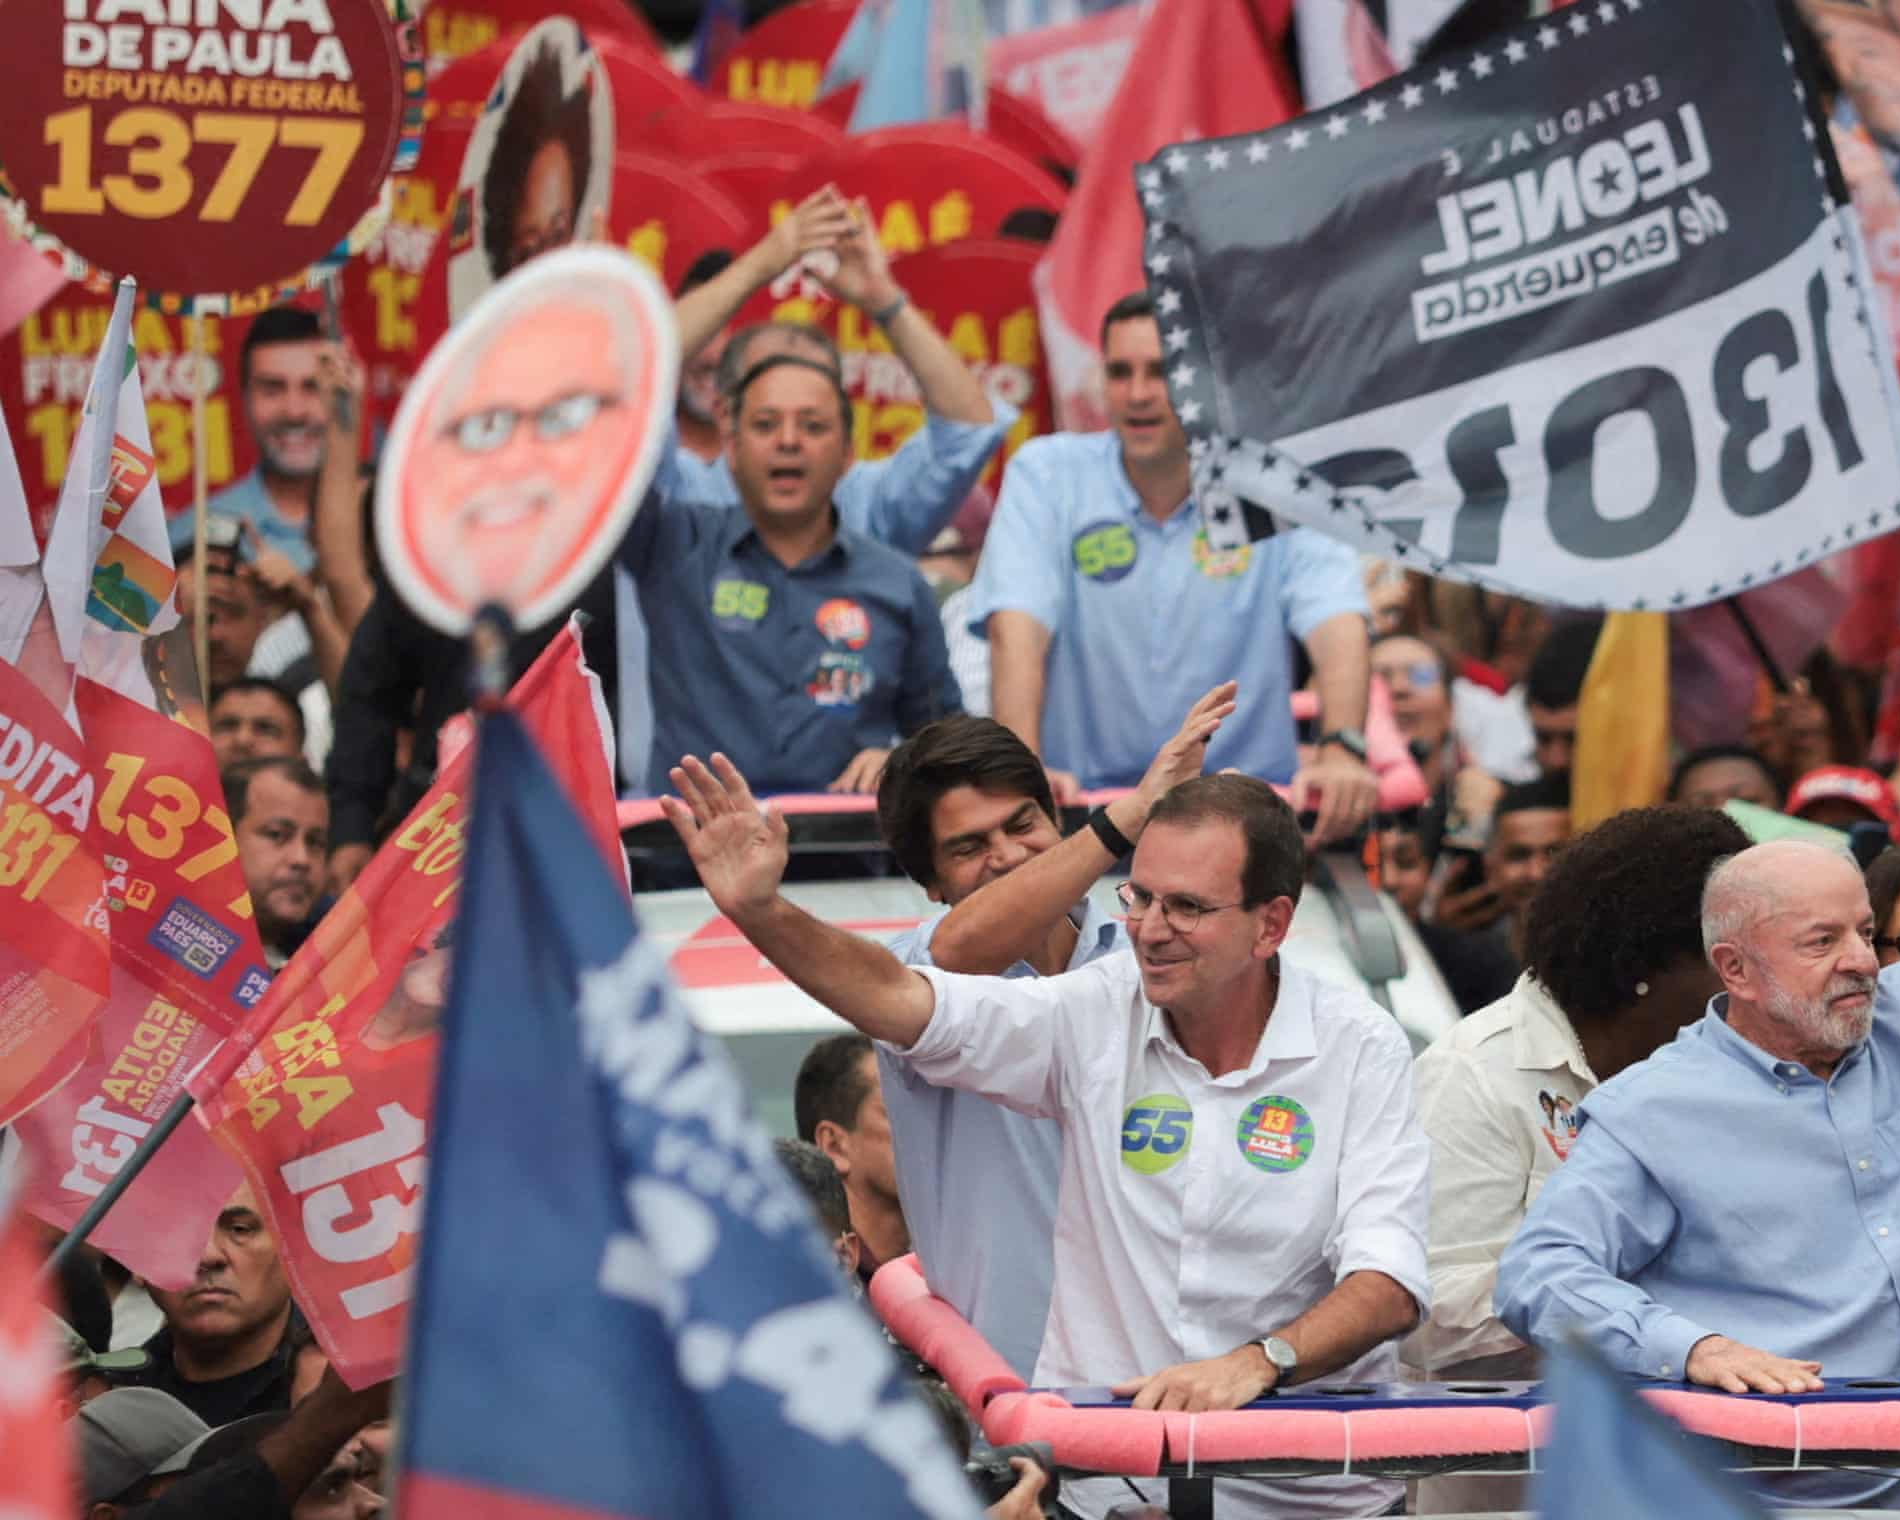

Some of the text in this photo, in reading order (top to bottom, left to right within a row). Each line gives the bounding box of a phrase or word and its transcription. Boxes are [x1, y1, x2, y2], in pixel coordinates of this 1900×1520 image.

[63, 22, 352, 81] DE PAULA
[64, 68, 364, 111] DEPUTADA FEDERAL
[41, 104, 366, 228] 1377
[26, 398, 235, 490] 131
[1075, 531, 1136, 577] 55
[713, 581, 768, 621] 55
[140, 922, 194, 949] PAES
[148, 911, 228, 955] EDUARDO
[1120, 1107, 1194, 1155] 55
[1263, 1109, 1289, 1131] 13
